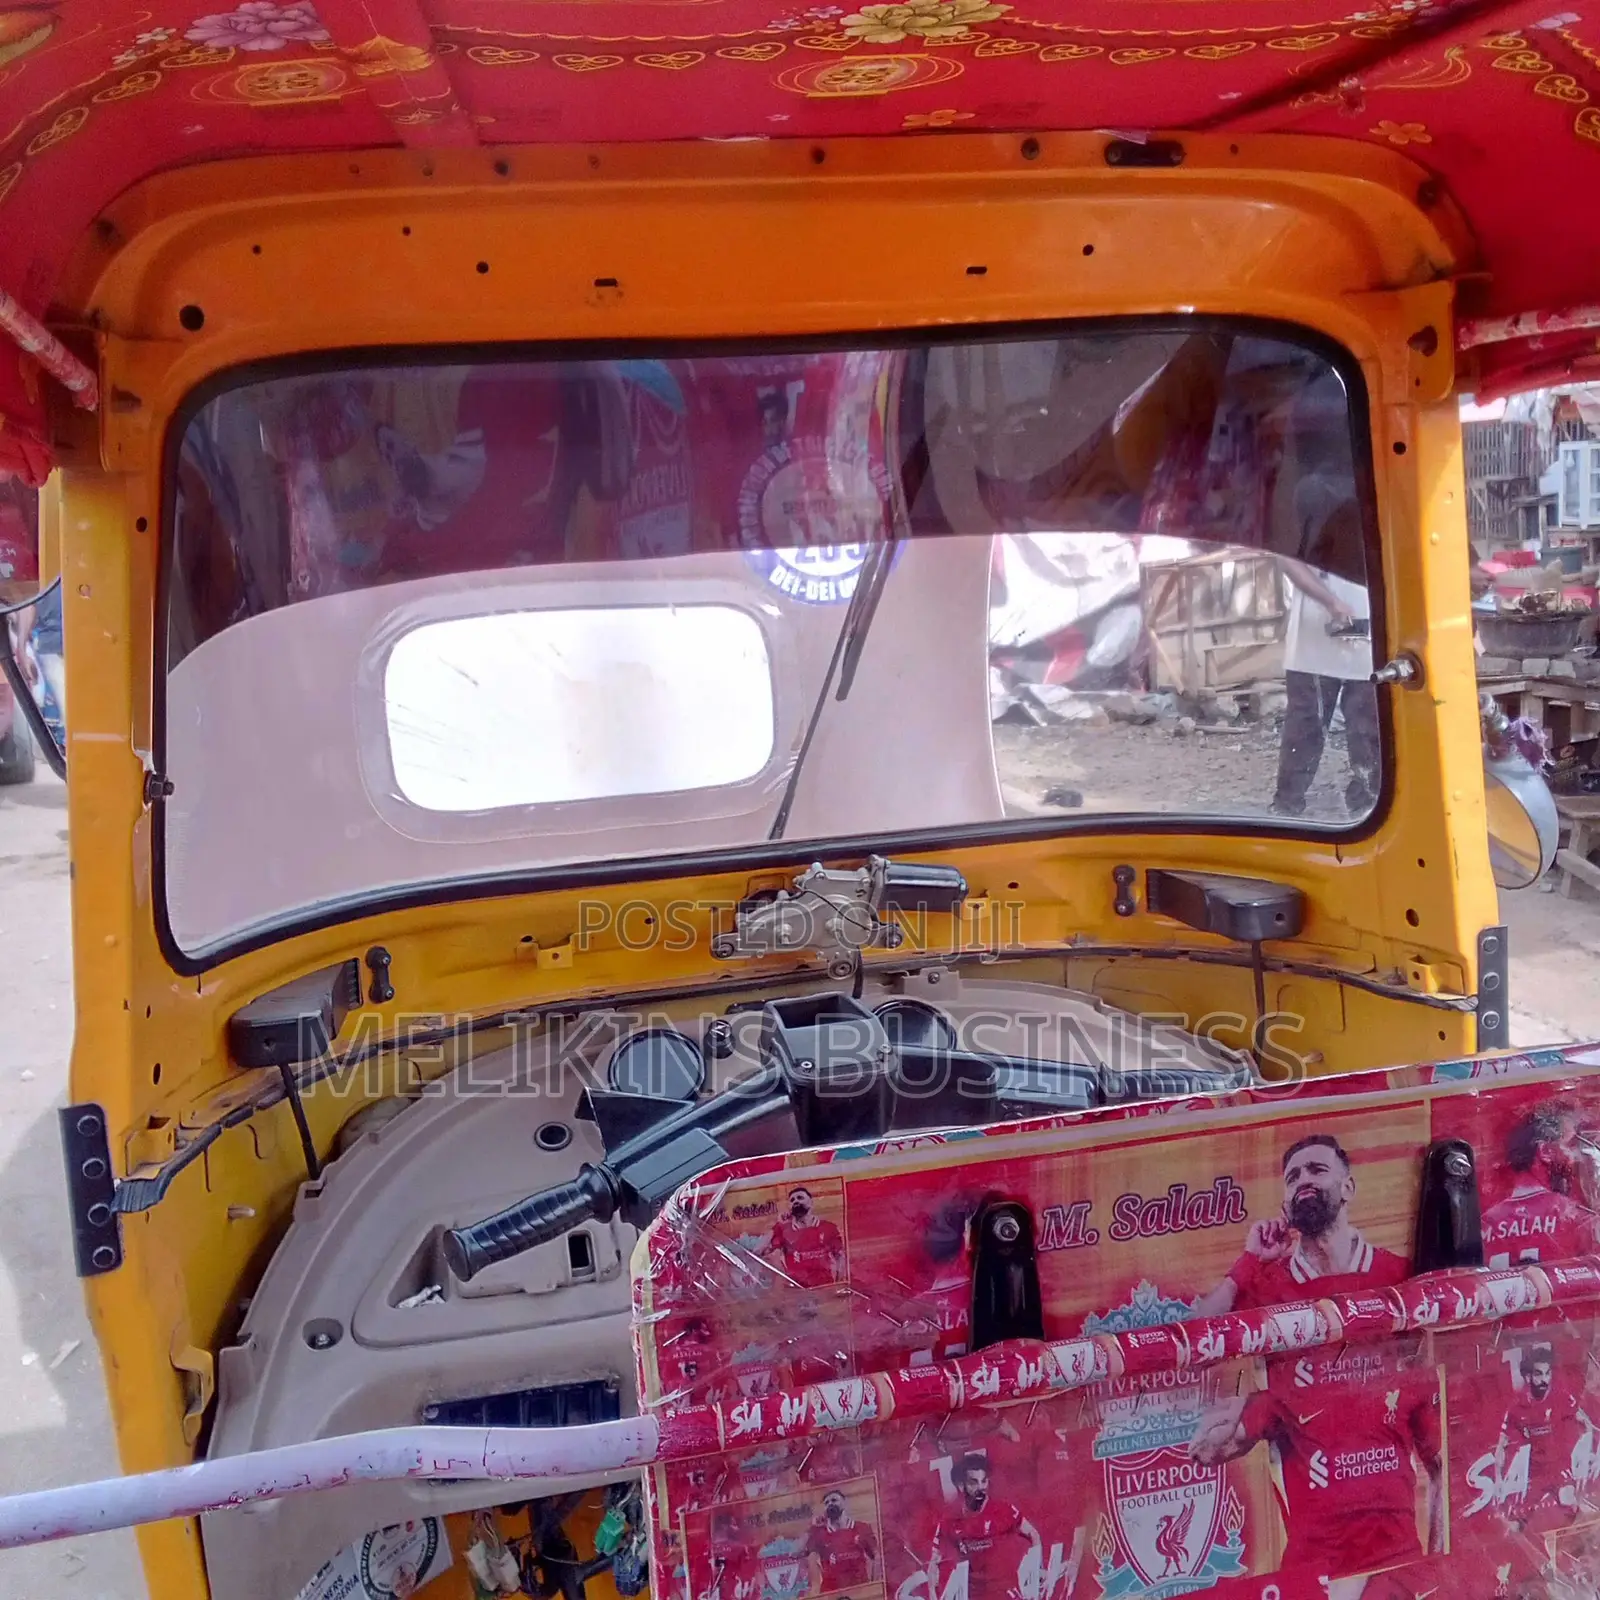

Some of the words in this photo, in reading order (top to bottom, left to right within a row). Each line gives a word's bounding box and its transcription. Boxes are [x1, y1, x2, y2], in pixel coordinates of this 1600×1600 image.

[1038, 1202, 1099, 1252] M.
[1108, 1175, 1247, 1242] Salah
[918, 1308, 969, 1333] SALA
[1103, 1391, 1161, 1414] FOOTALL
[1334, 1445, 1396, 1467] standard
[1116, 1462, 1217, 1496] LIVERPOOL
[1334, 1457, 1400, 1481] chartered
[1121, 1490, 1181, 1511] FOOTBALL
[1183, 1483, 1214, 1500] CLUB
